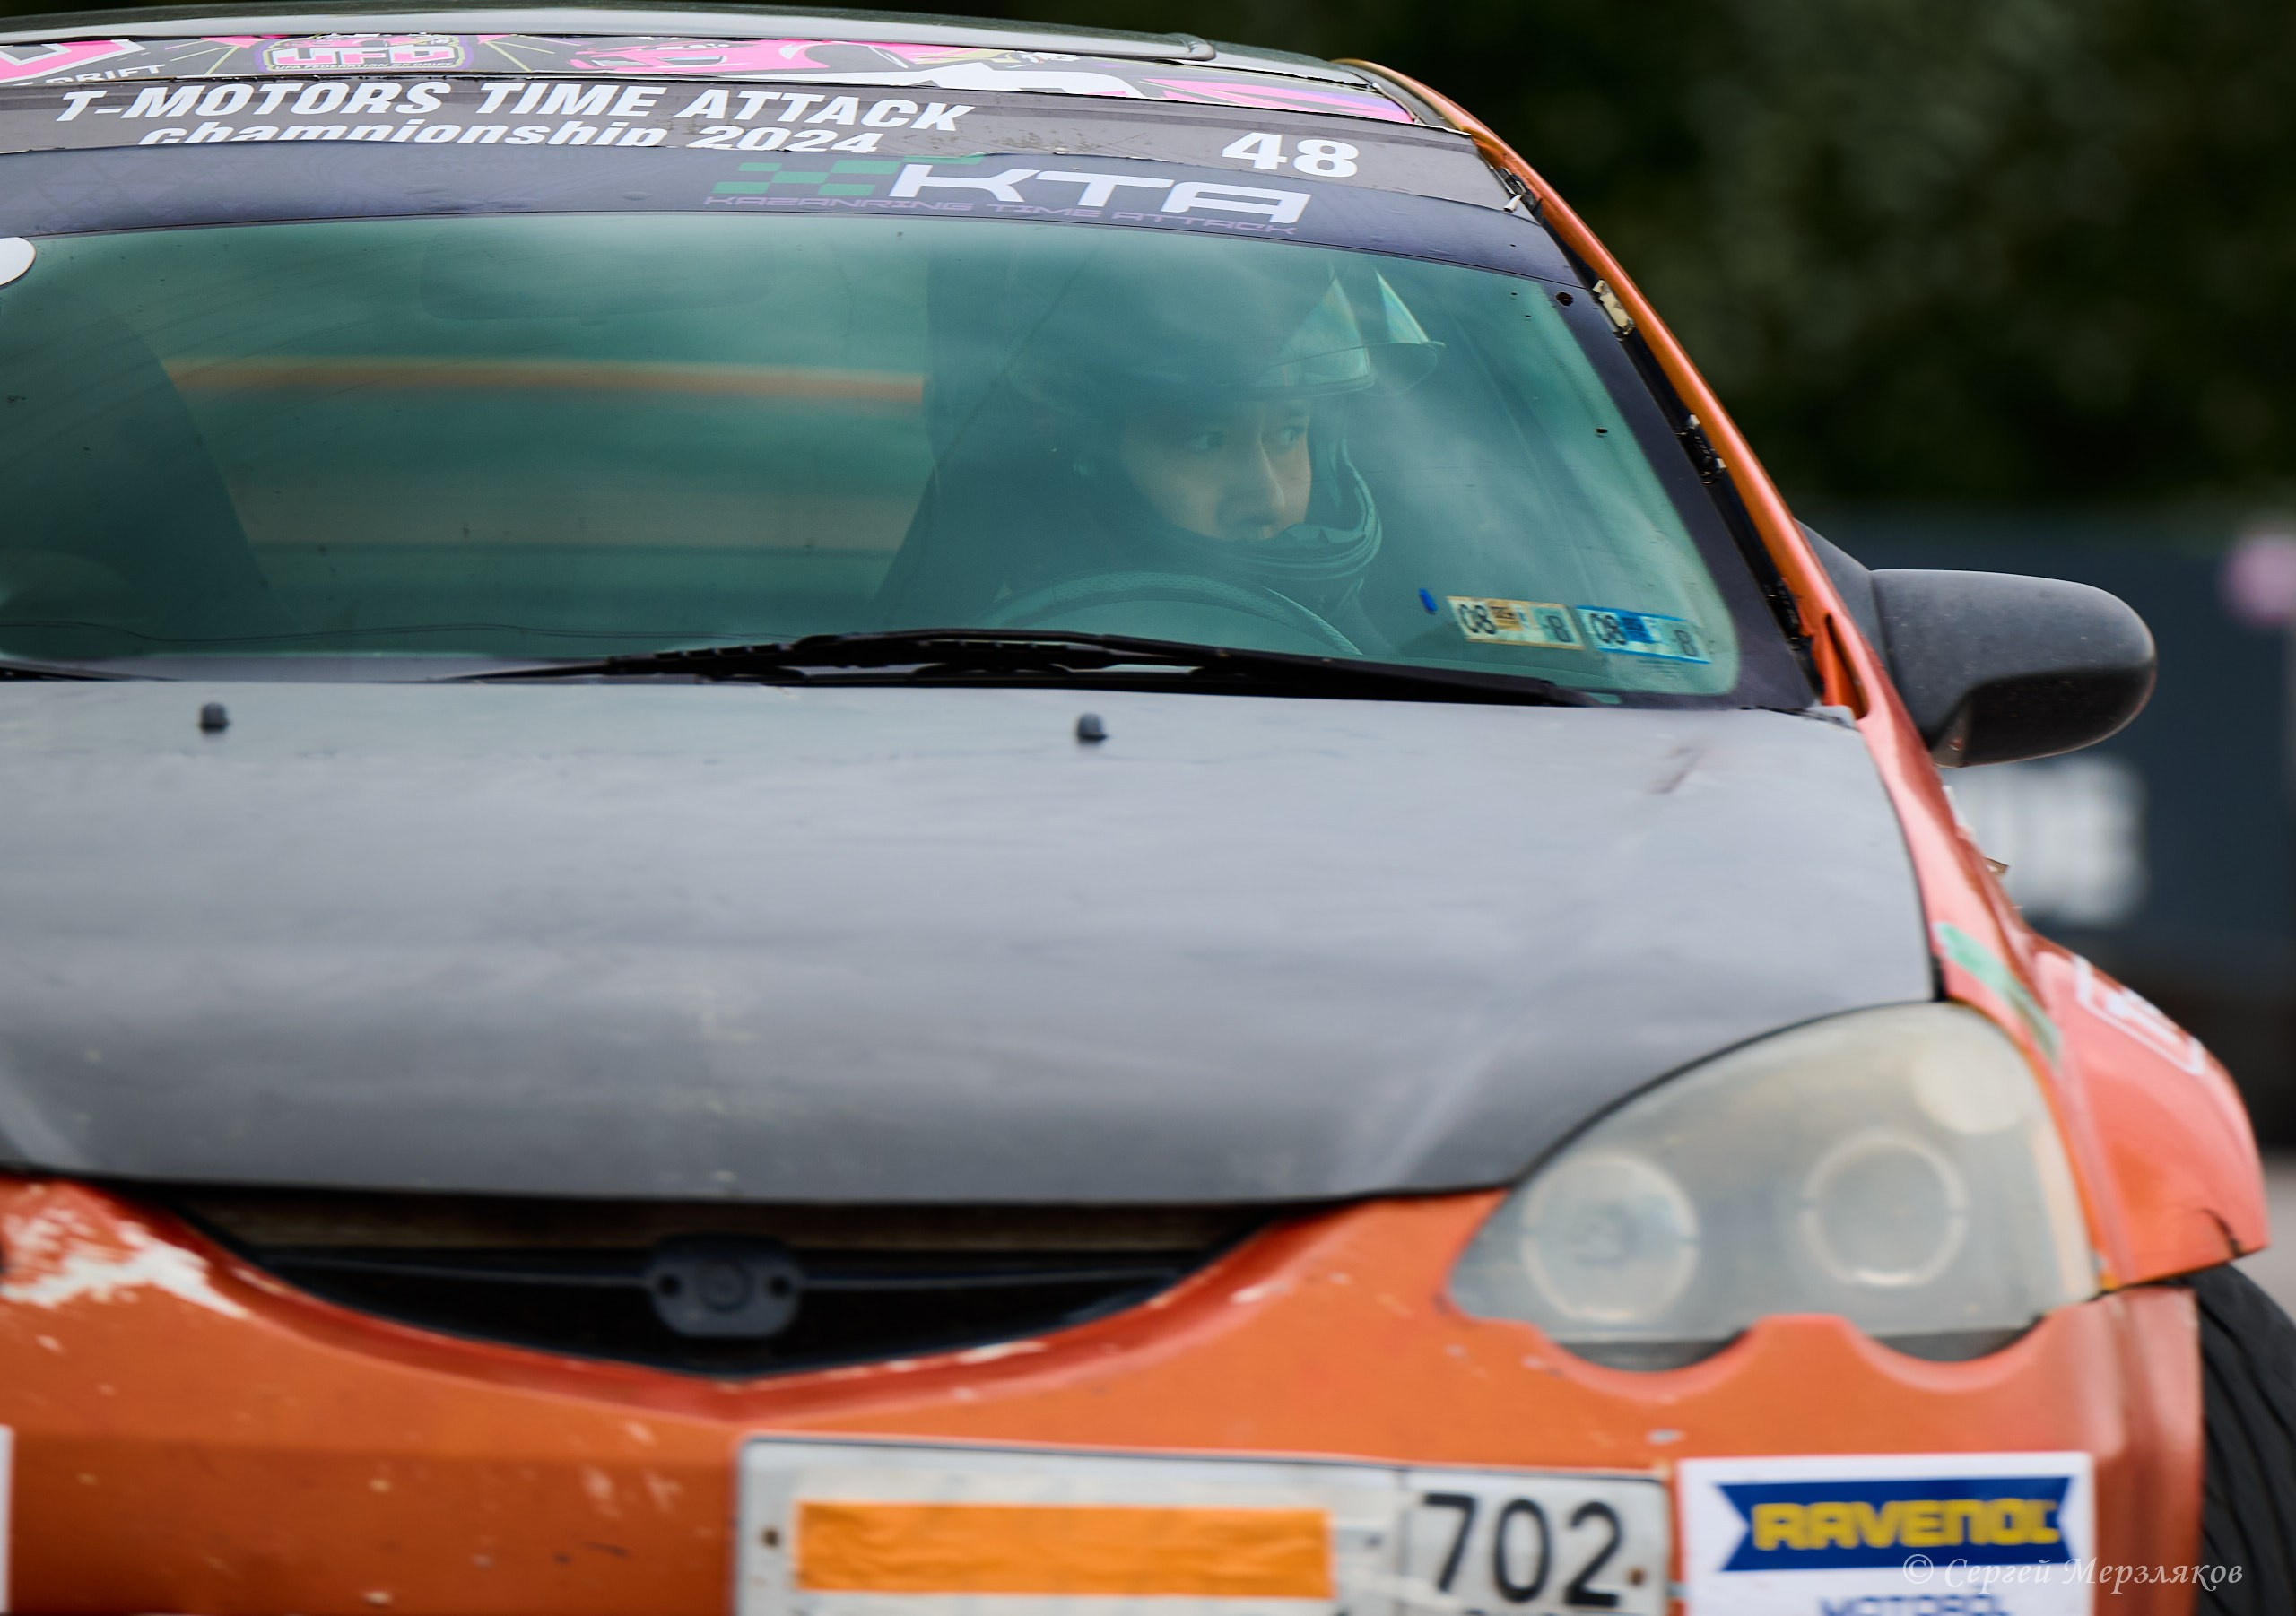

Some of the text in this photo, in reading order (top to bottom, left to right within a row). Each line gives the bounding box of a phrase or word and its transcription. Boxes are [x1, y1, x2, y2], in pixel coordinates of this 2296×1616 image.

[46, 64, 165, 83] DRIFT
[56, 82, 976, 132] T-MOTORS TIME ATTACK
[685, 125, 884, 153] 2024
[1222, 132, 1359, 178] 48
[888, 163, 1312, 224] KTA
[985, 204, 1102, 218] TIME
[1111, 211, 1298, 235] ATTACK
[1751, 1498, 2061, 1551] RAVENOL
[1421, 1492, 1623, 1608] 702
